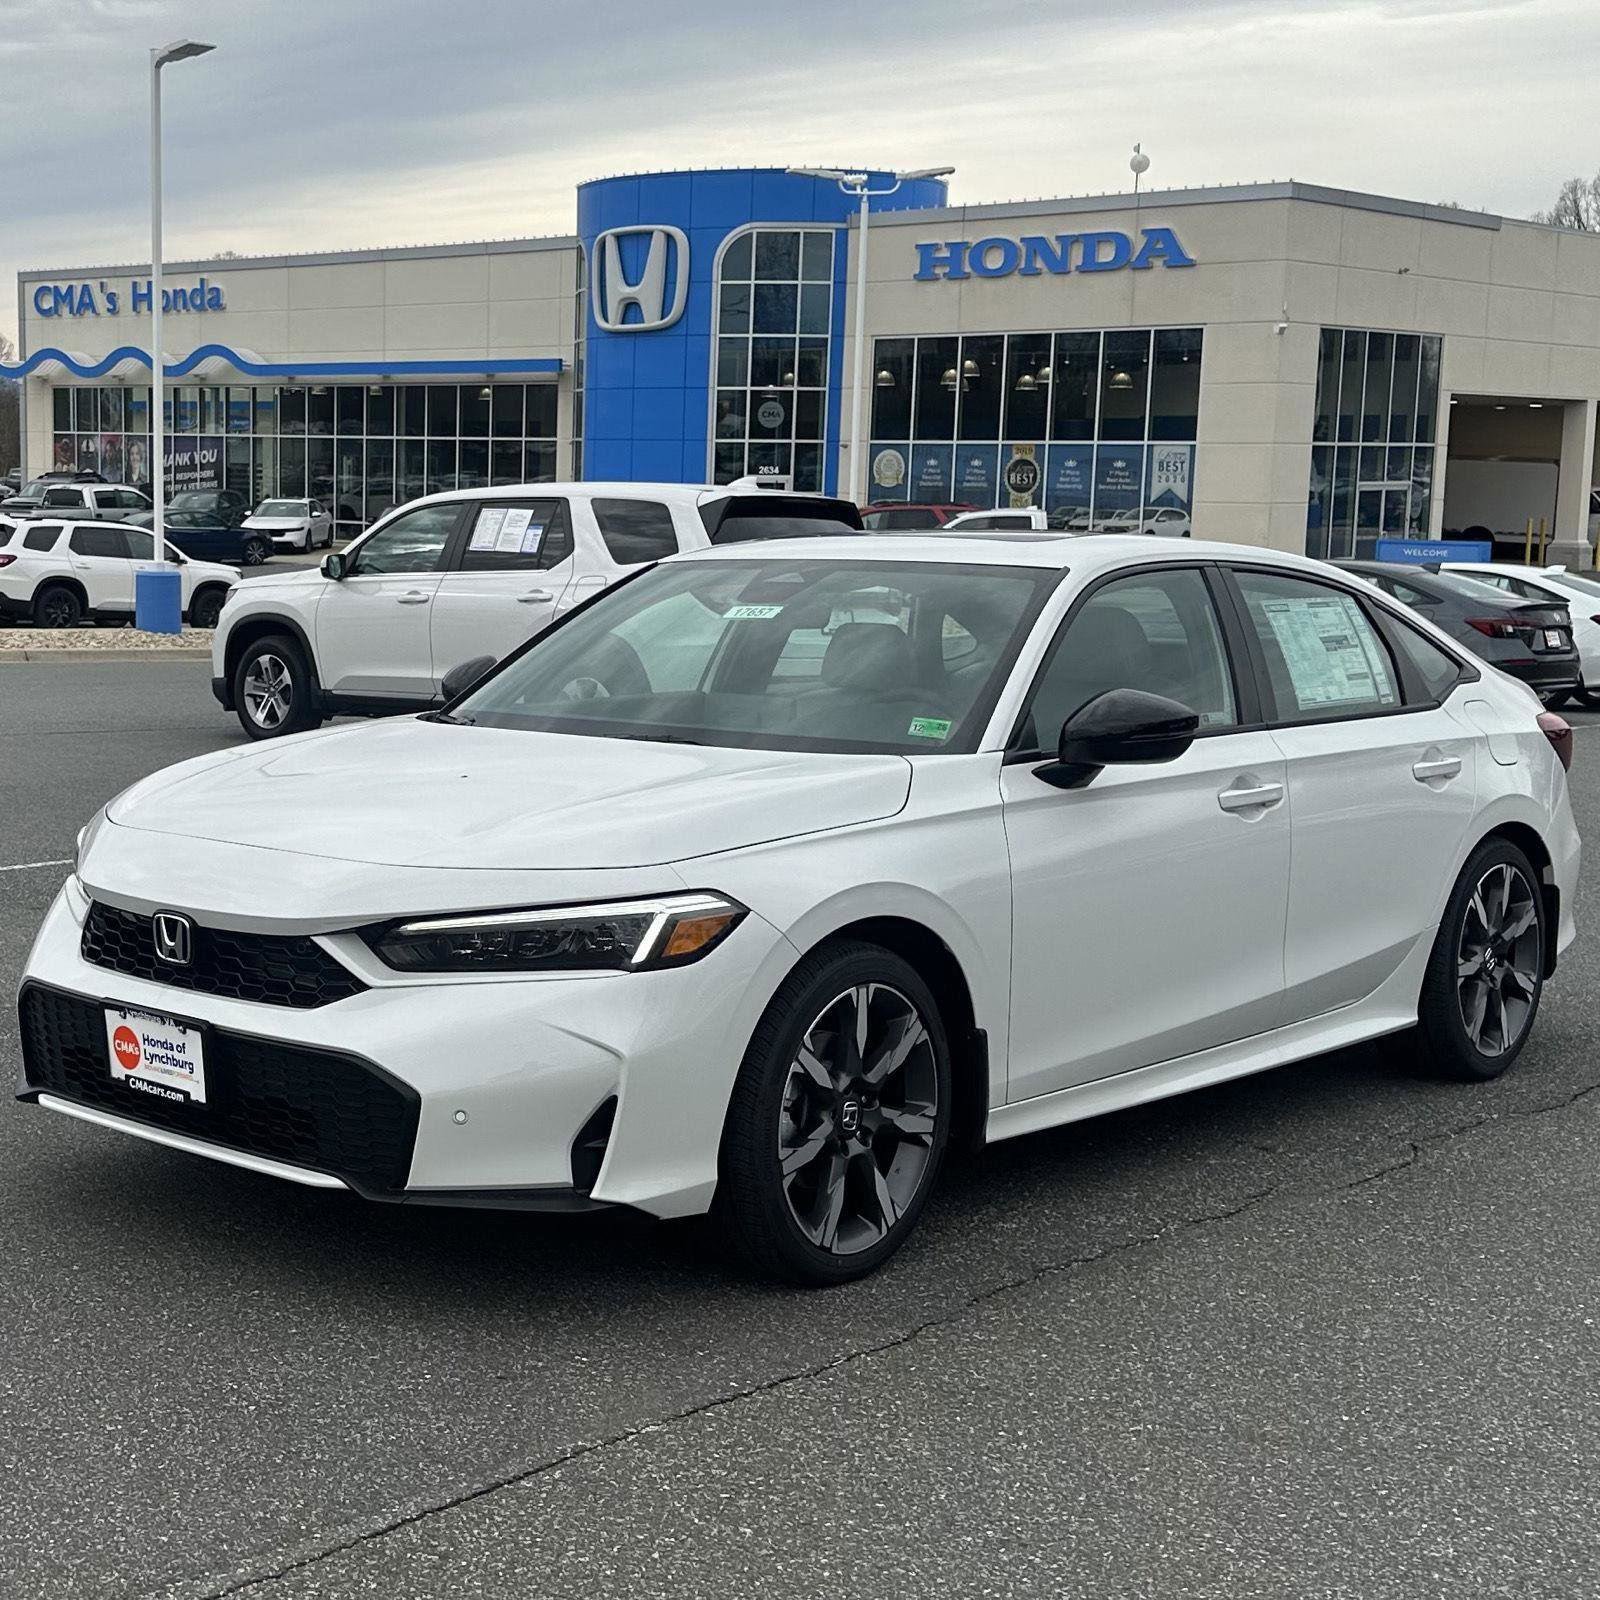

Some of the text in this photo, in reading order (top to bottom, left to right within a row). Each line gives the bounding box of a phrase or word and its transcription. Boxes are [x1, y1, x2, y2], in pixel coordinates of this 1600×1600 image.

[913, 228, 1197, 281] HONDA
[33, 277, 226, 317] CMA's Honda
[193, 449, 217, 464] YOU
[759, 466, 779, 474] 2634
[1158, 460, 1185, 472] BEST
[1010, 472, 1034, 485] BEST
[1403, 548, 1448, 557] WELCOME
[733, 607, 775, 616] 17657
[913, 723, 925, 731] 12
[115, 1039, 140, 1055] CMA's
[142, 1033, 187, 1054] Honda of
[144, 1048, 194, 1074] Lynchburg
[129, 1078, 184, 1103] CMAcars.com
